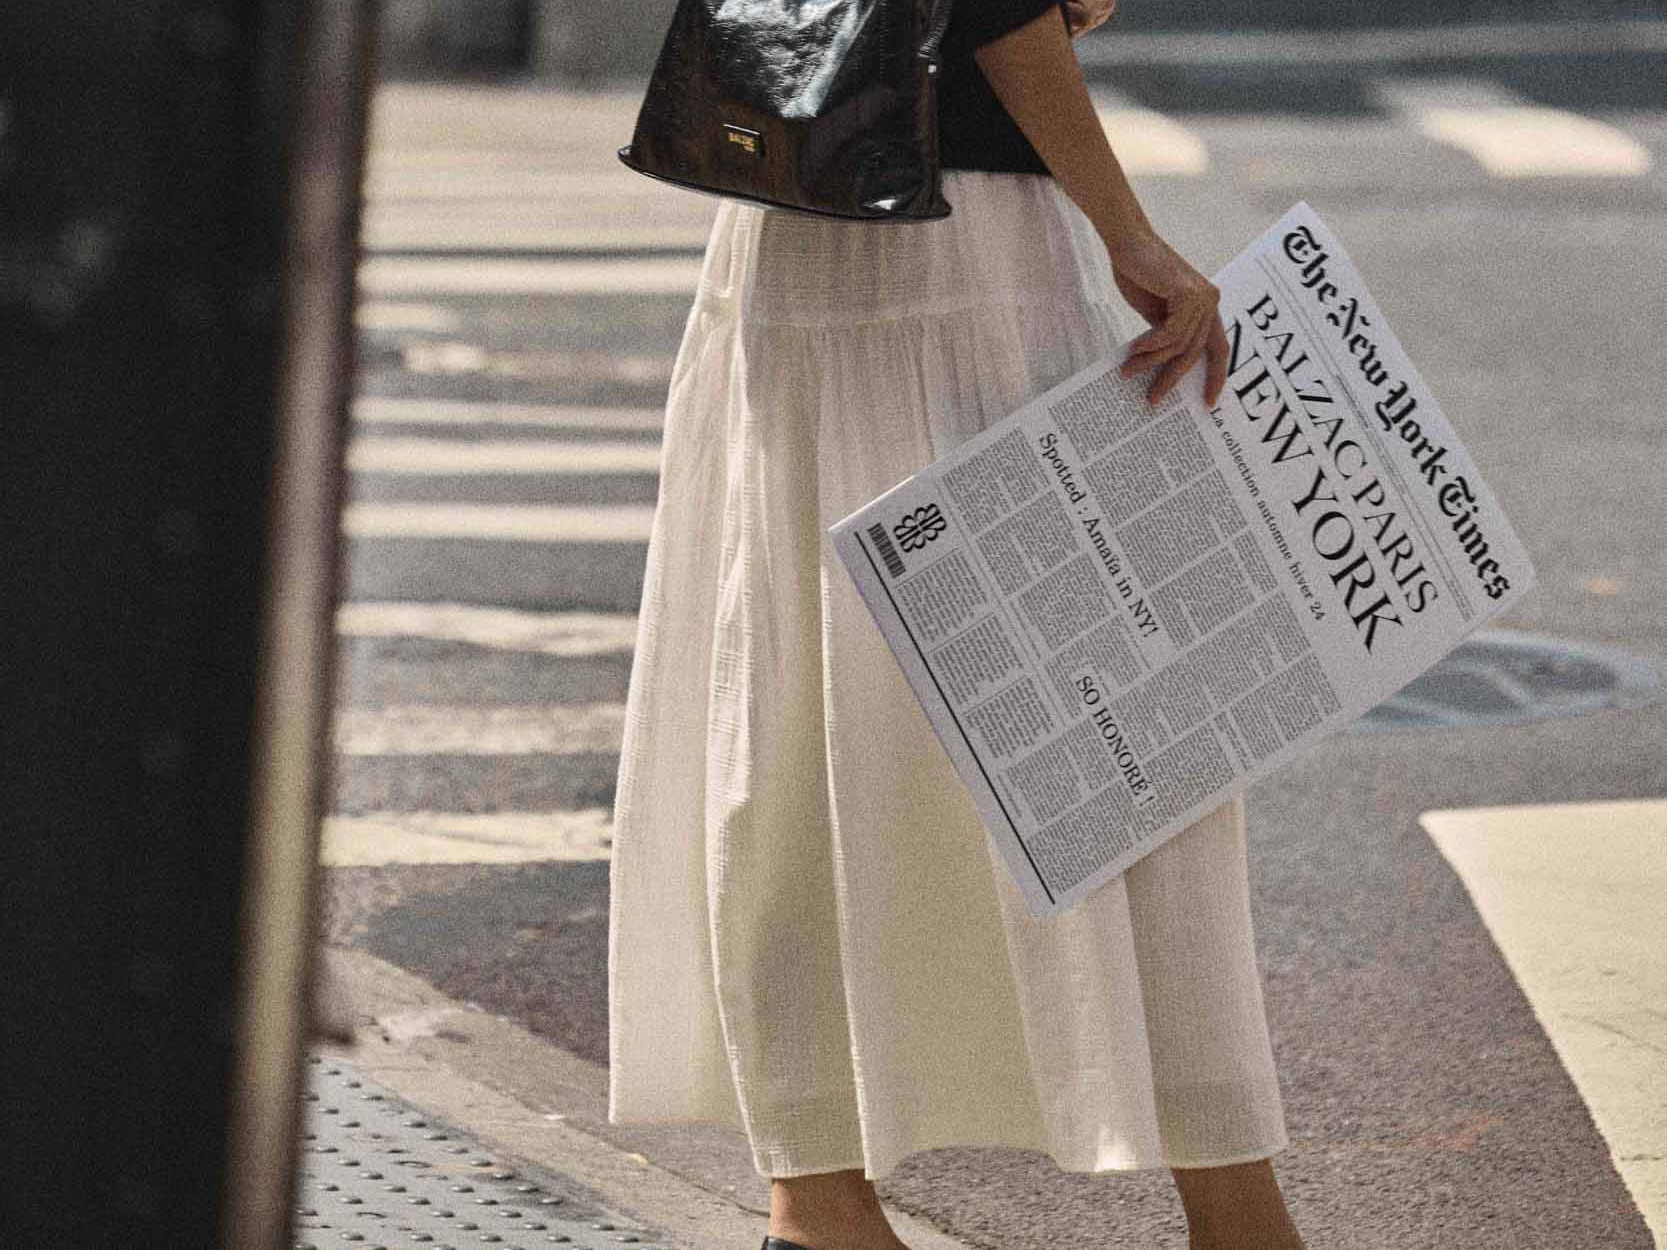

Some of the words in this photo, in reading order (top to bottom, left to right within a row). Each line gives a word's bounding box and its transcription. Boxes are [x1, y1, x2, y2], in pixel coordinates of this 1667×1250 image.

[1038, 431, 1088, 506] Spotted
[1081, 517, 1122, 578] Amaïa
[1114, 575, 1134, 600] in
[1127, 596, 1160, 639] NY!
[1208, 405, 1225, 430] La
[1220, 430, 1261, 499] collection
[1255, 499, 1294, 561] automne
[1287, 560, 1315, 600] hiver
[1308, 600, 1327, 622] 24
[1223, 319, 1315, 464] NEW
[1292, 467, 1403, 652] YORK
[1246, 293, 1368, 481] BALZAC
[1351, 478, 1439, 614] PARIS
[1282, 225, 1338, 303] The
[1326, 297, 1389, 387] New
[1374, 381, 1448, 487] York
[1437, 475, 1511, 600] Times
[1074, 674, 1102, 707] SO
[1091, 706, 1154, 798] HONORÉ
